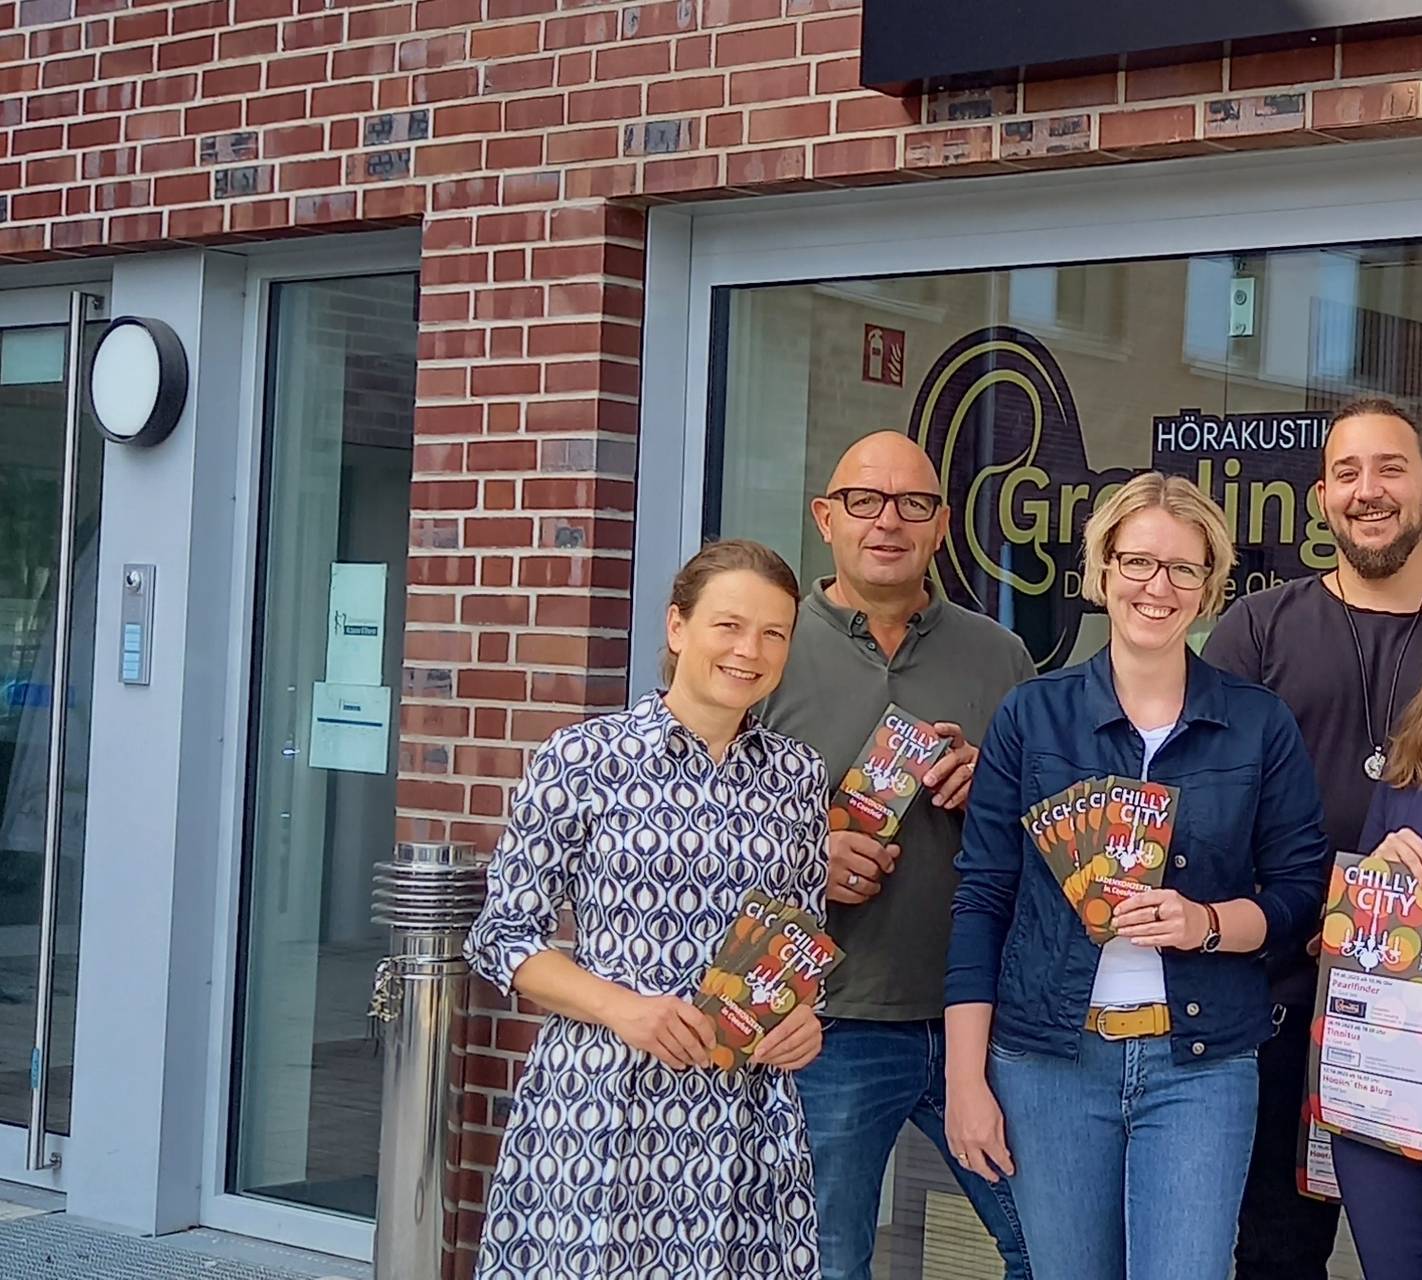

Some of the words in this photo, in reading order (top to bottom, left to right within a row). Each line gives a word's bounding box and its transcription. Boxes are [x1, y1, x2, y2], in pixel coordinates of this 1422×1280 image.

[886, 716, 939, 750] CHILLY
[888, 734, 933, 764] CITY
[1111, 786, 1172, 811] CHILLY
[1120, 805, 1168, 829] CITY
[1344, 866, 1418, 894] CHILLY
[1357, 888, 1417, 917] CITY
[784, 923, 833, 968] CHILLY
[780, 944, 822, 980] CITY
